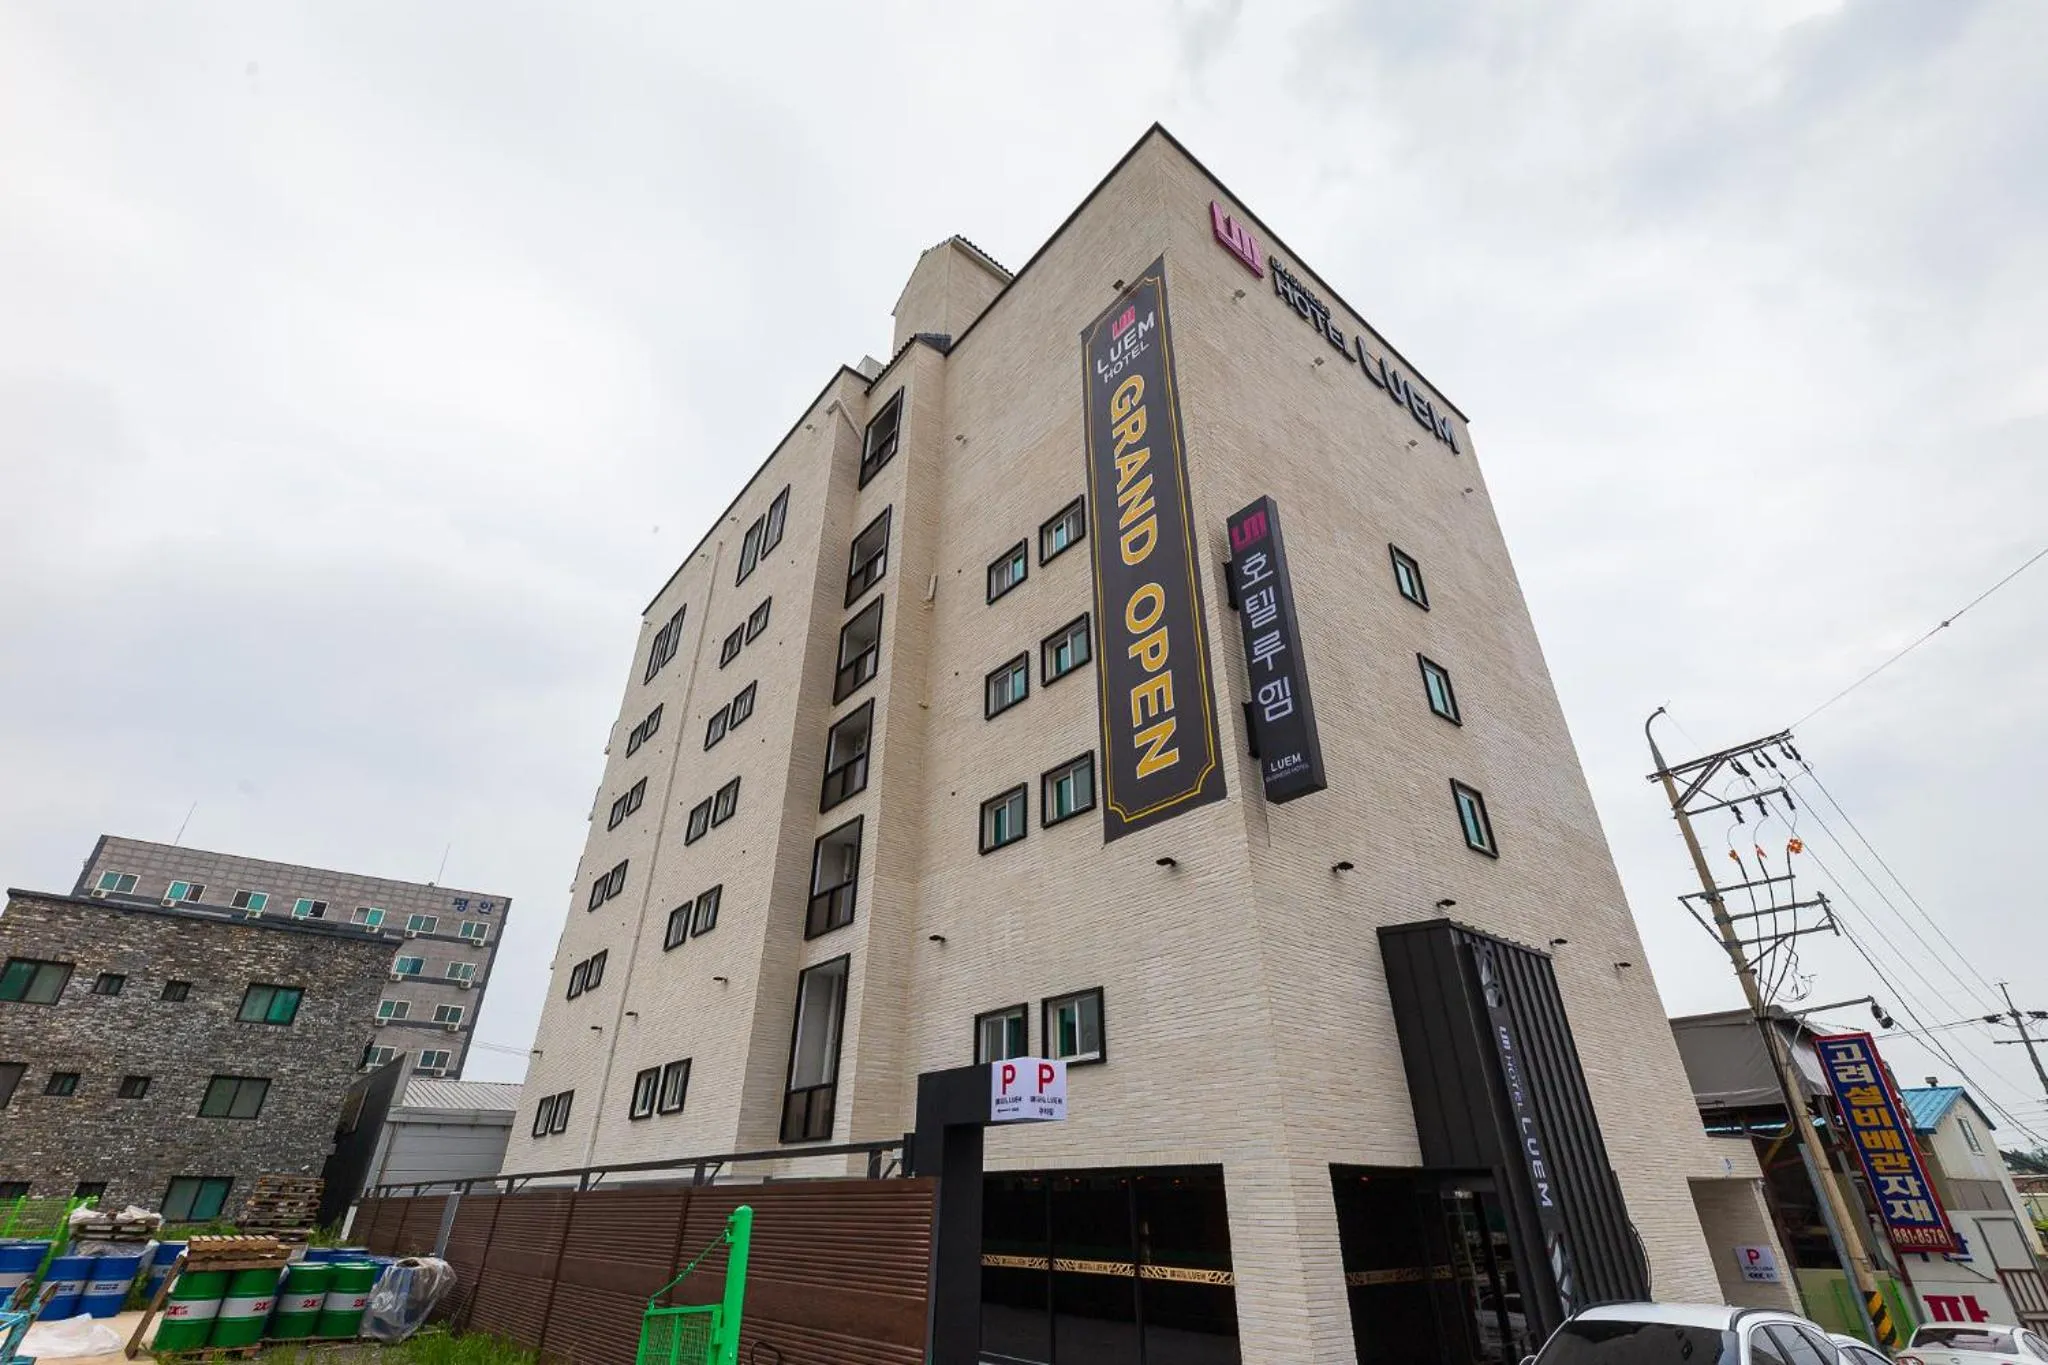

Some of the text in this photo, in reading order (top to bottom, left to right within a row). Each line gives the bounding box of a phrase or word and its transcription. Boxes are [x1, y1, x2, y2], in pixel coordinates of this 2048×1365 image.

[1097, 311, 1155, 374] LUEM
[1103, 341, 1150, 384] HOTEL
[1273, 270, 1357, 363] HOTEL
[1355, 335, 1460, 455] LUEM
[1111, 374, 1180, 779] GRAND OPEN
[1270, 752, 1302, 772] LUEM
[1002, 1064, 1016, 1095] P
[1038, 1063, 1055, 1094] P
[1521, 1116, 1553, 1206] LUEM
[1746, 1249, 1760, 1265] P
